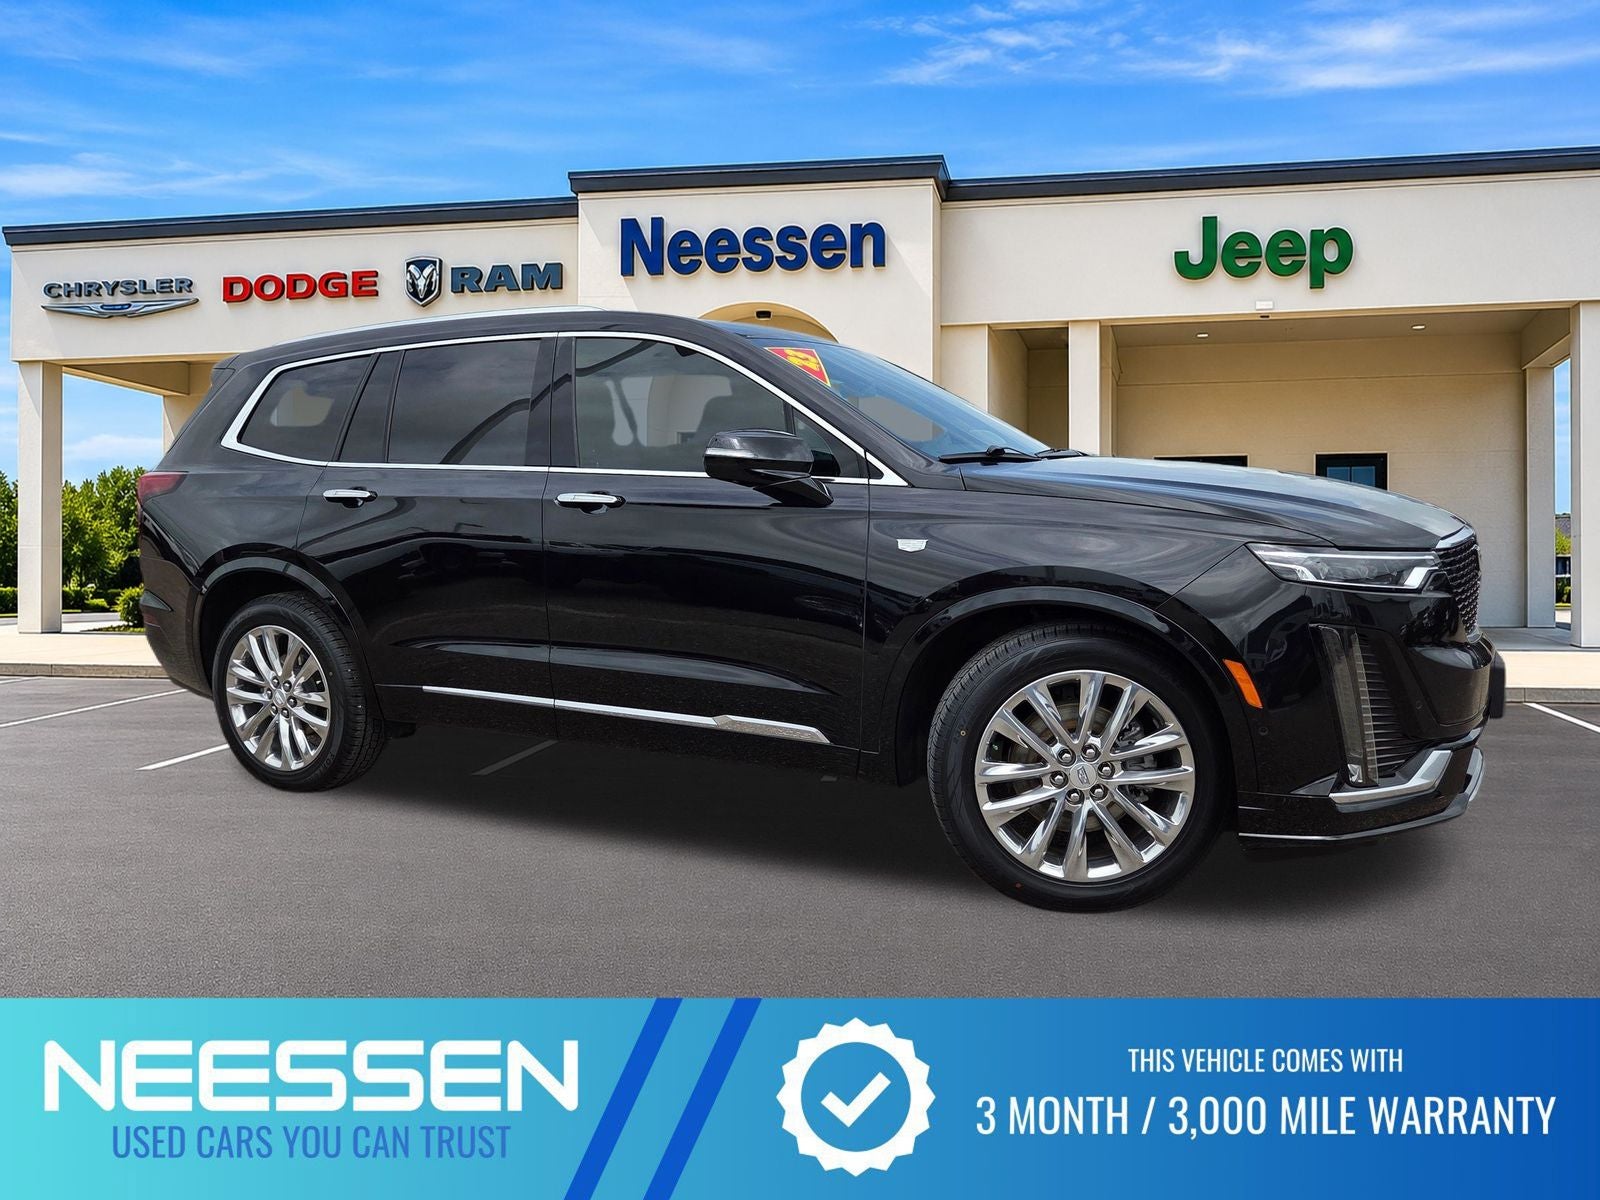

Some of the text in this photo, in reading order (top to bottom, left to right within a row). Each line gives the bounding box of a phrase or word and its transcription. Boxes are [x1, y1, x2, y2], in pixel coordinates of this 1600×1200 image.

[620, 217, 887, 276] Neessen
[1174, 216, 1353, 289] Jeep
[43, 278, 193, 299] CHRYSLER
[222, 270, 378, 302] DODGE
[450, 262, 563, 293] RAM
